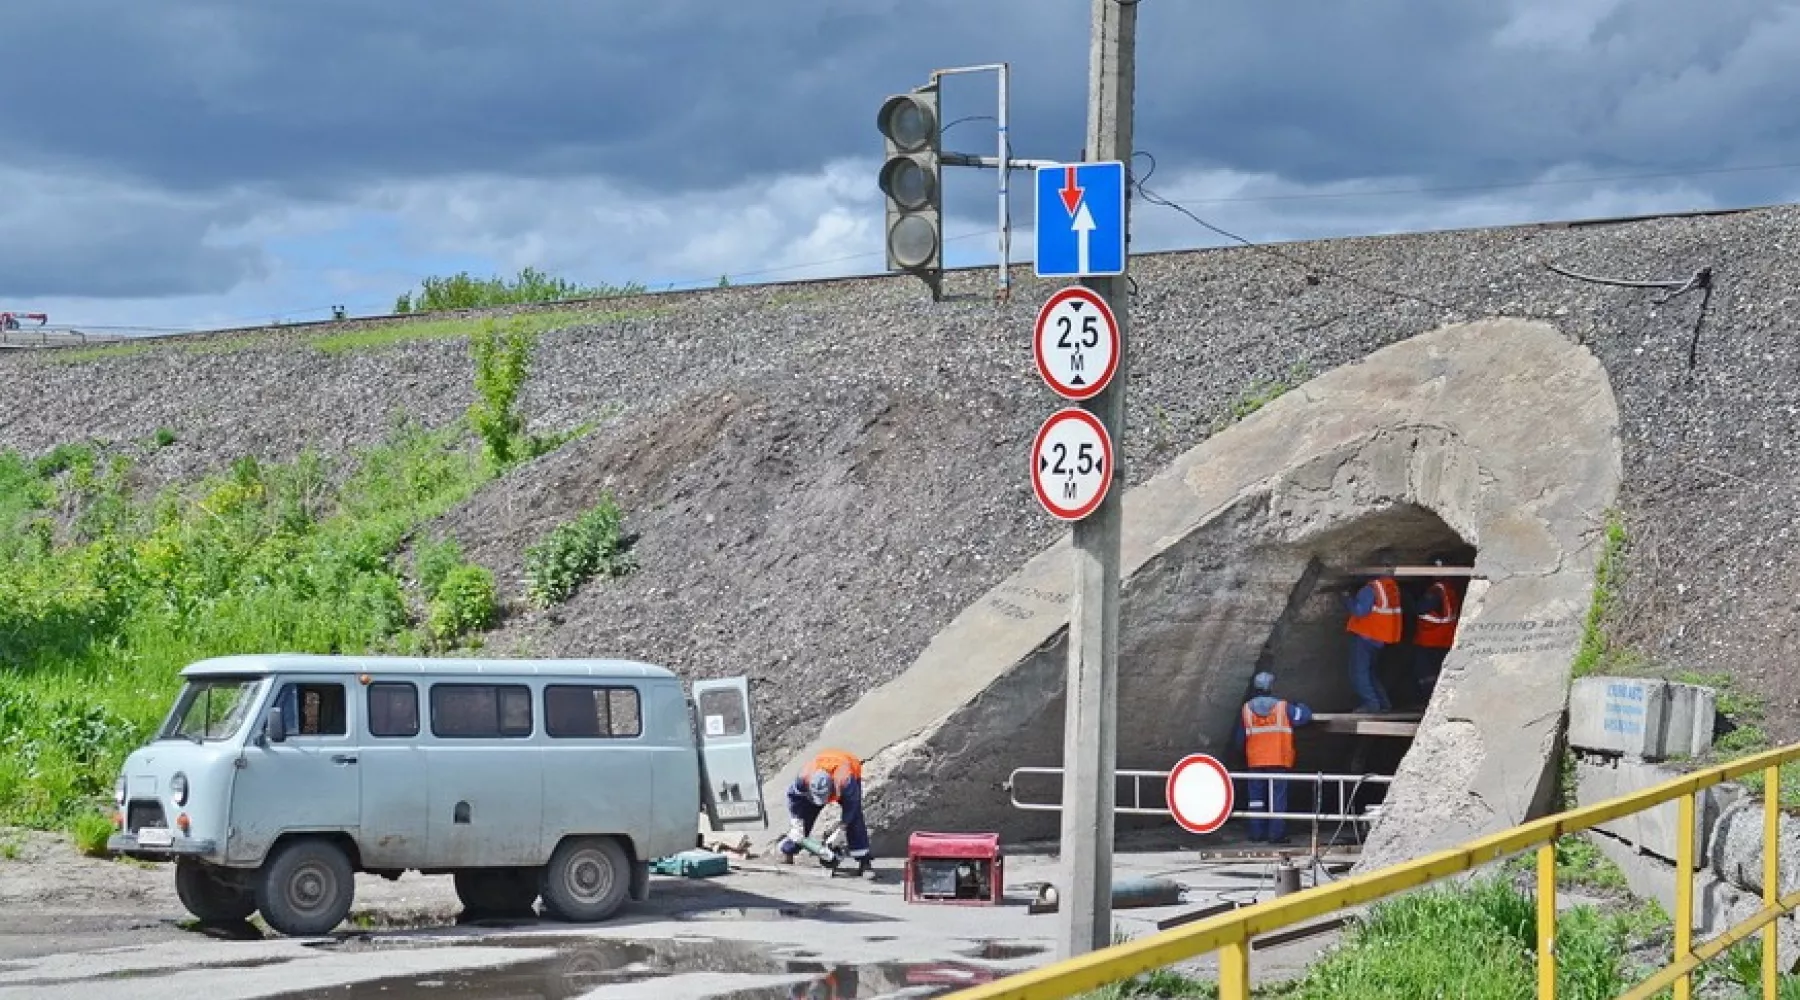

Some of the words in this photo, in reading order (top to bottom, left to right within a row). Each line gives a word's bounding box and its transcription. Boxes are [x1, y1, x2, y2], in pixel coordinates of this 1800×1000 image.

[1056, 315, 1099, 353] 2,5
[1070, 355, 1084, 371] М
[1052, 443, 1093, 481] 2,5
[1063, 482, 1077, 499] М
